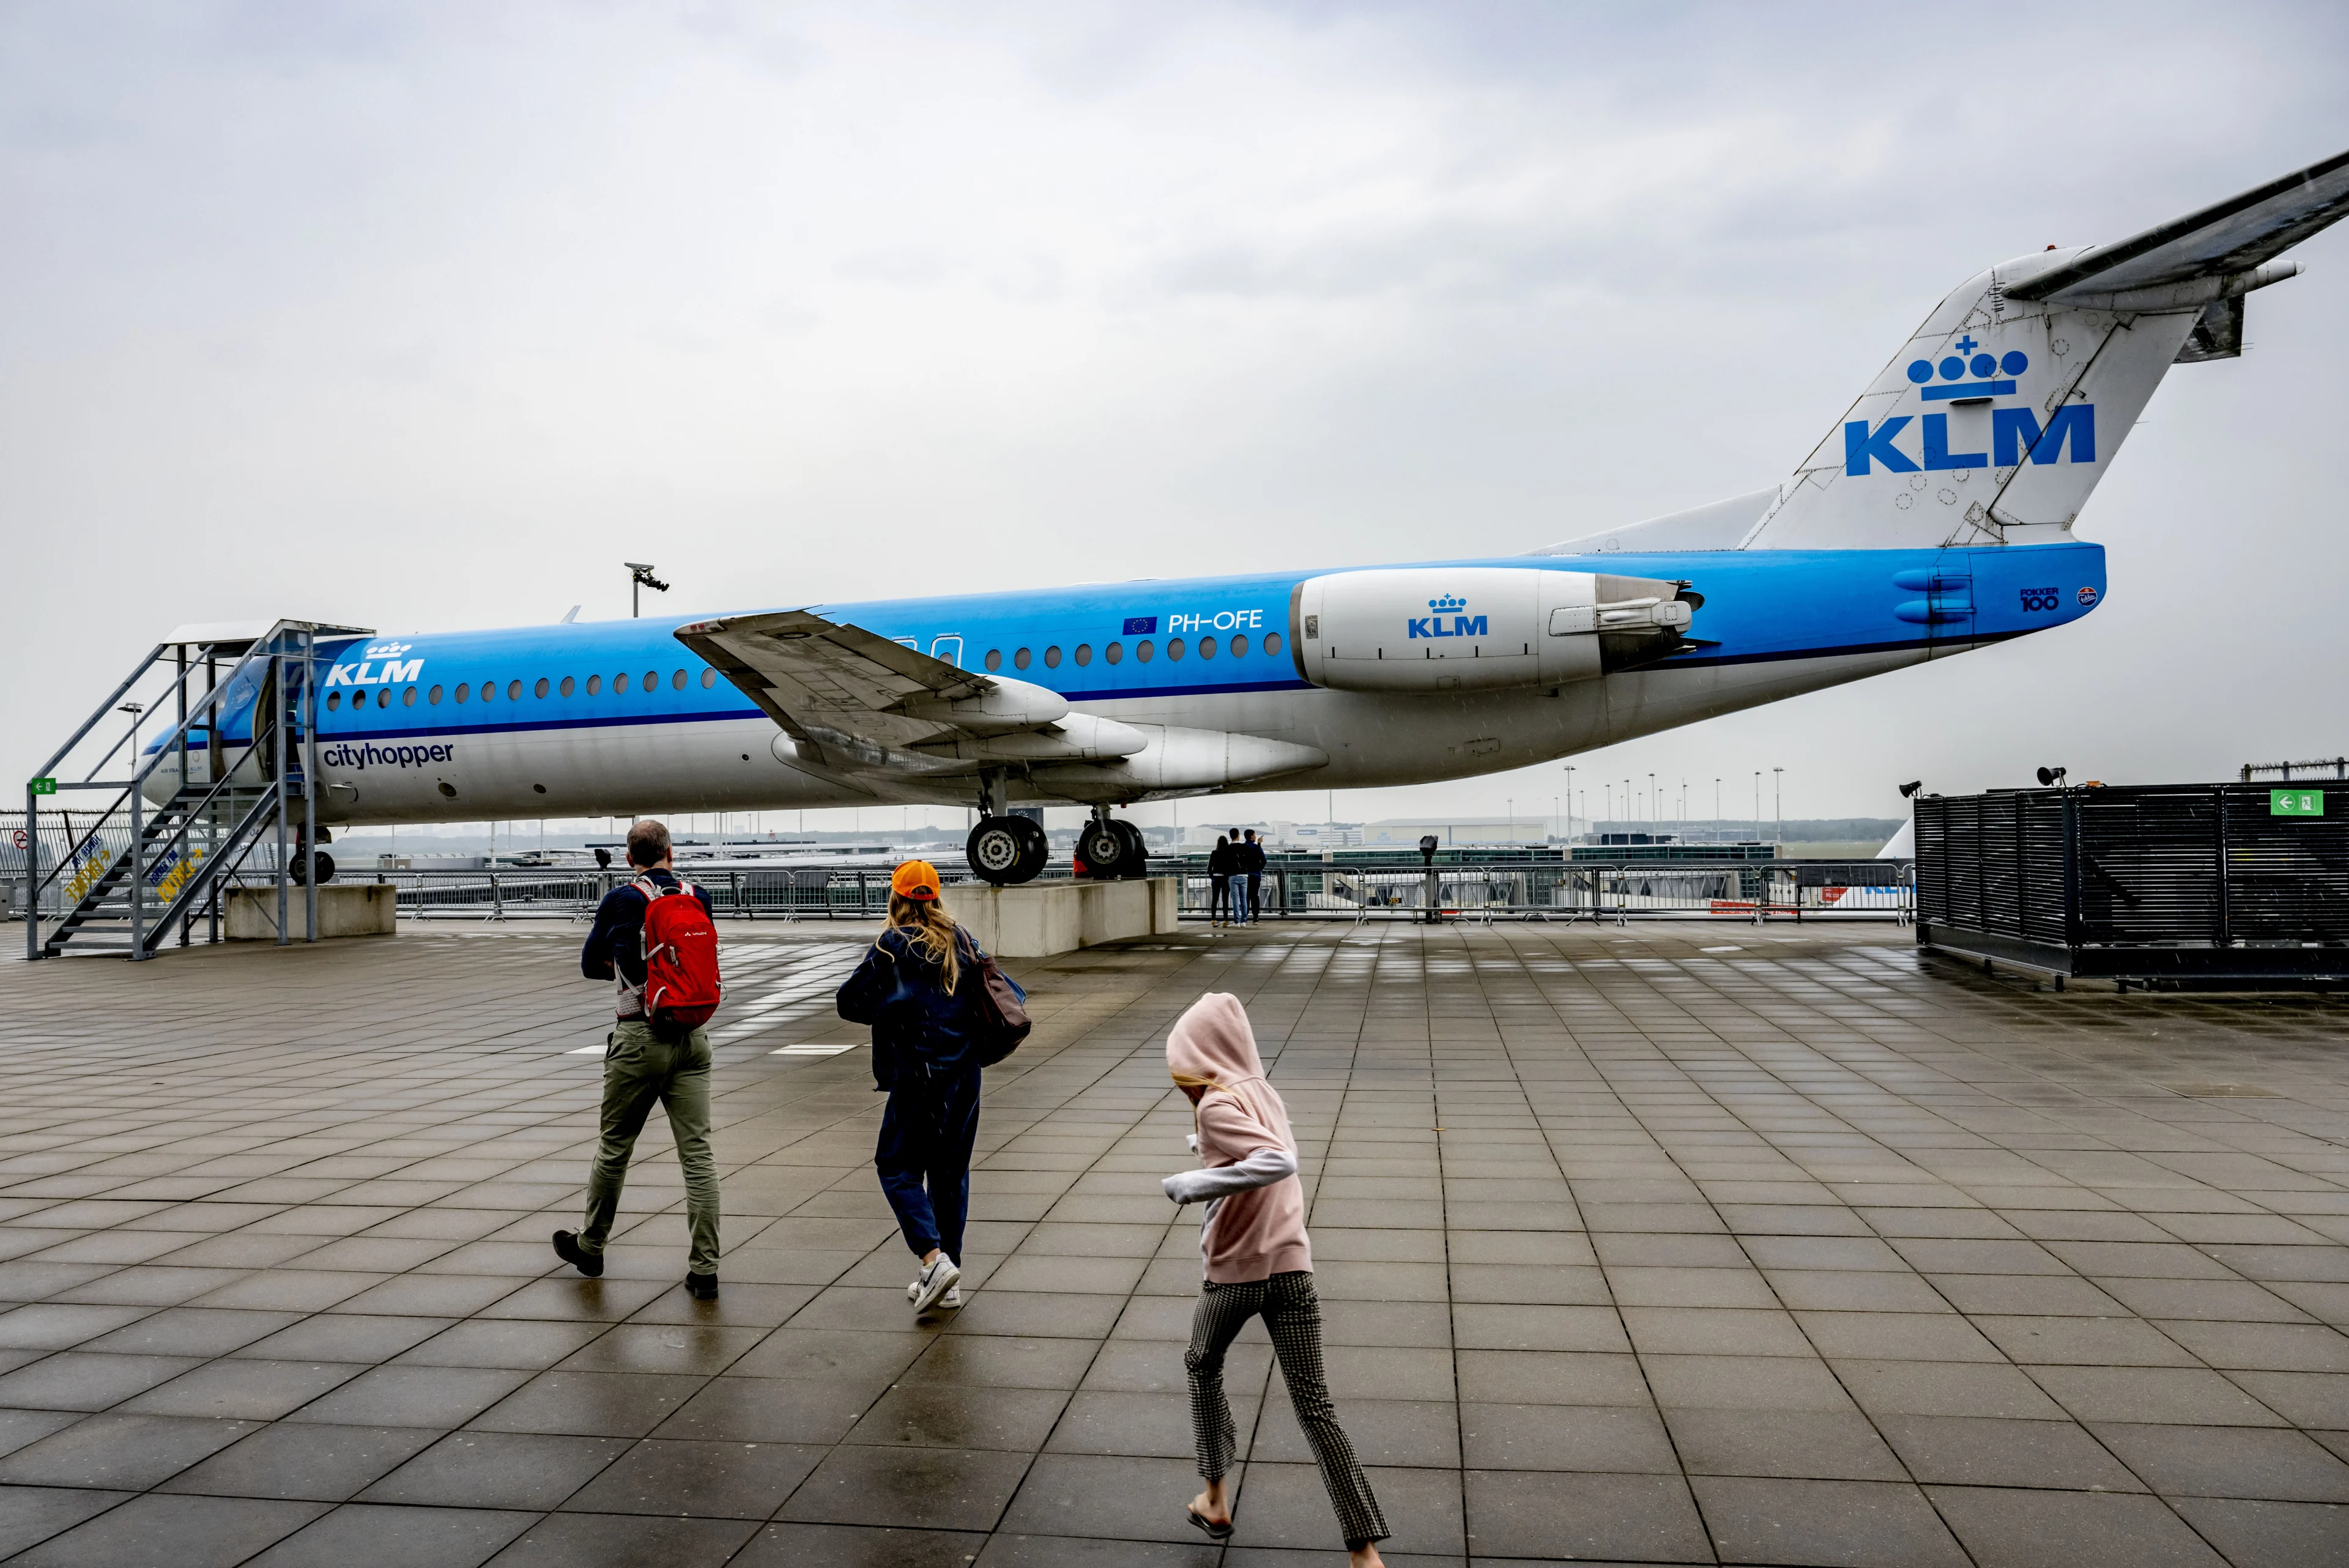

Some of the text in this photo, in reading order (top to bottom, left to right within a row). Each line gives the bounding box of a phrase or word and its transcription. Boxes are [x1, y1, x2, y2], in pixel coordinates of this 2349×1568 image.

[1844, 404, 2096, 477] KLM
[2020, 587, 2058, 596] FOKKER
[2021, 596, 2059, 612] 100
[1168, 609, 1263, 634] PH-OFE
[1408, 615, 1488, 639] KLM
[325, 659, 425, 687] KLM
[324, 742, 454, 770] cityhopper
[149, 849, 178, 885] FOKKER 100
